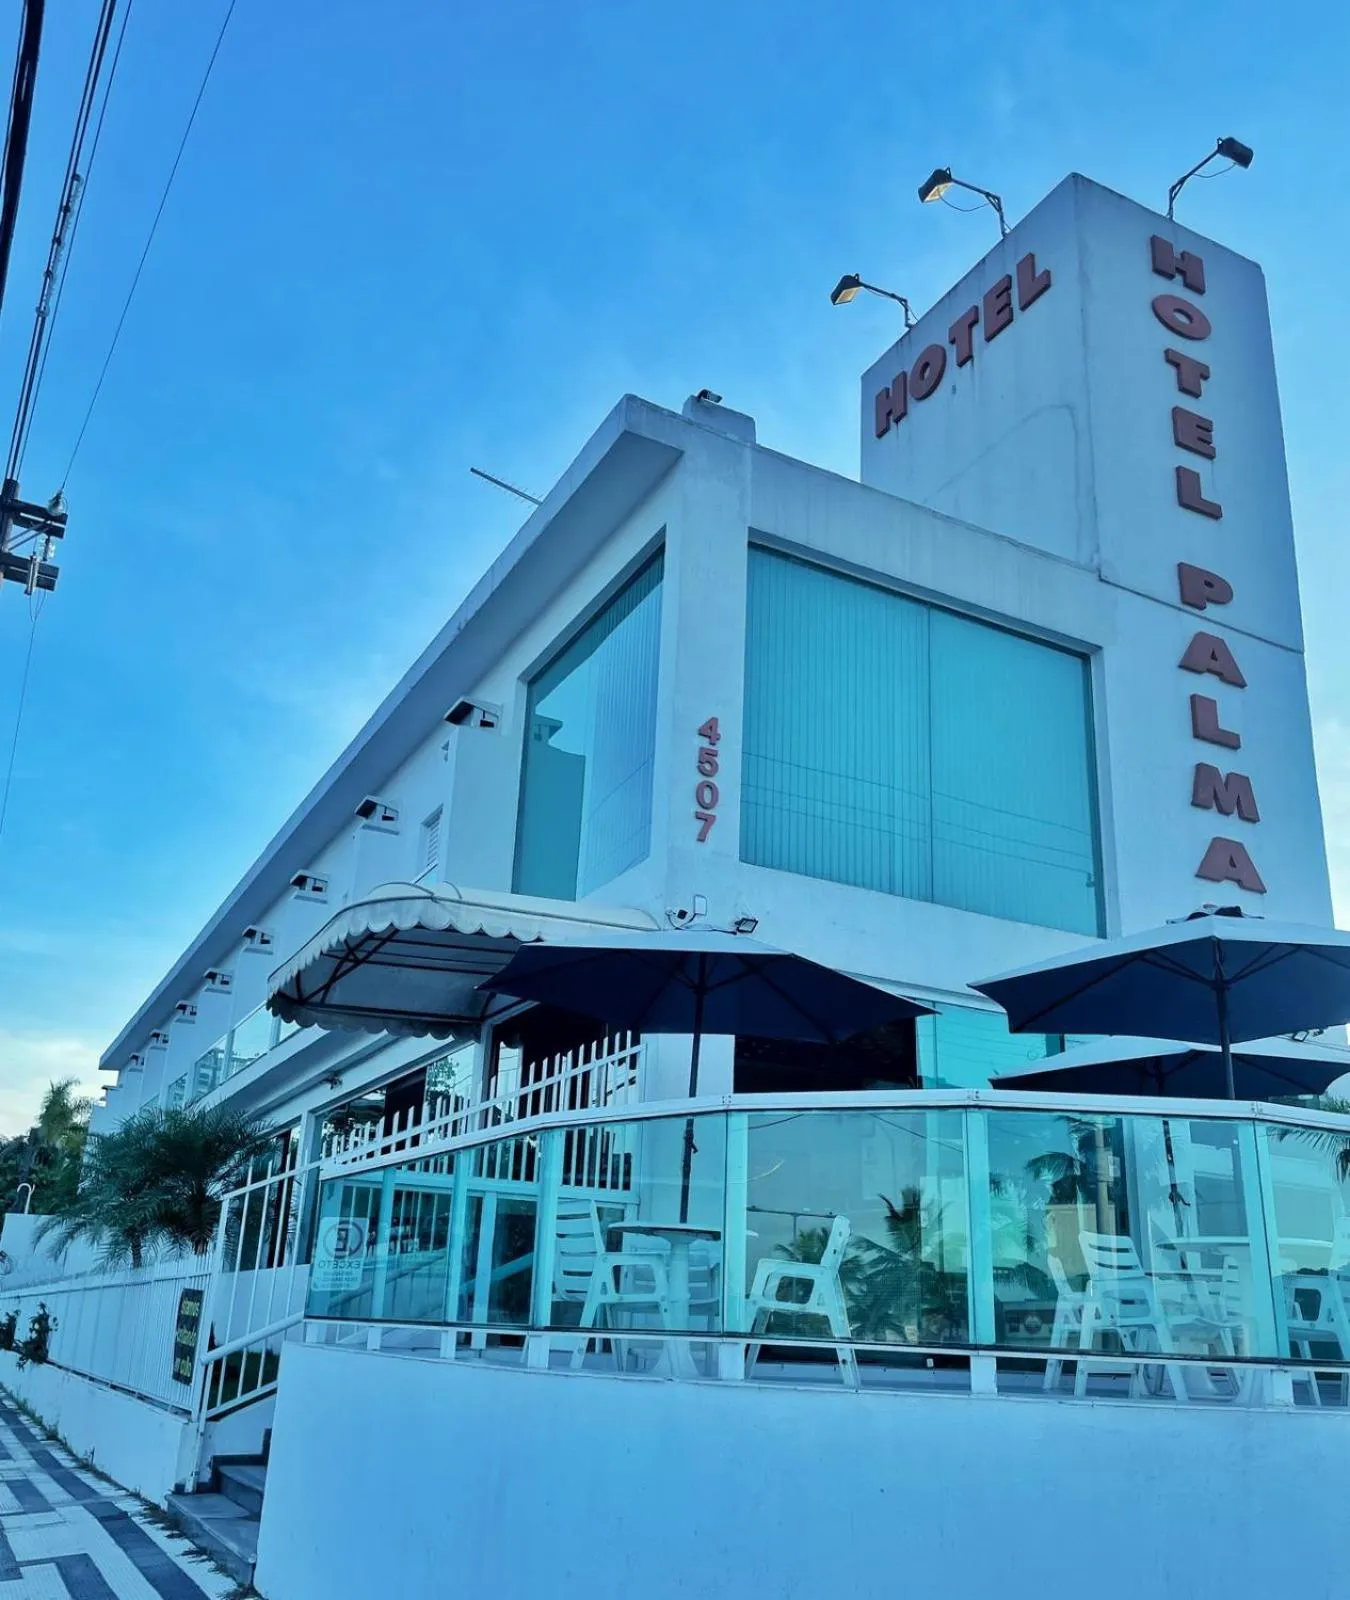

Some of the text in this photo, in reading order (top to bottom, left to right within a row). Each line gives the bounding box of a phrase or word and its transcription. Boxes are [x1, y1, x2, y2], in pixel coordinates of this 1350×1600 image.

[875, 252, 1052, 438] HOTEL
[1150, 234, 1267, 894] HOTEL PALMA
[694, 717, 721, 842] 4507
